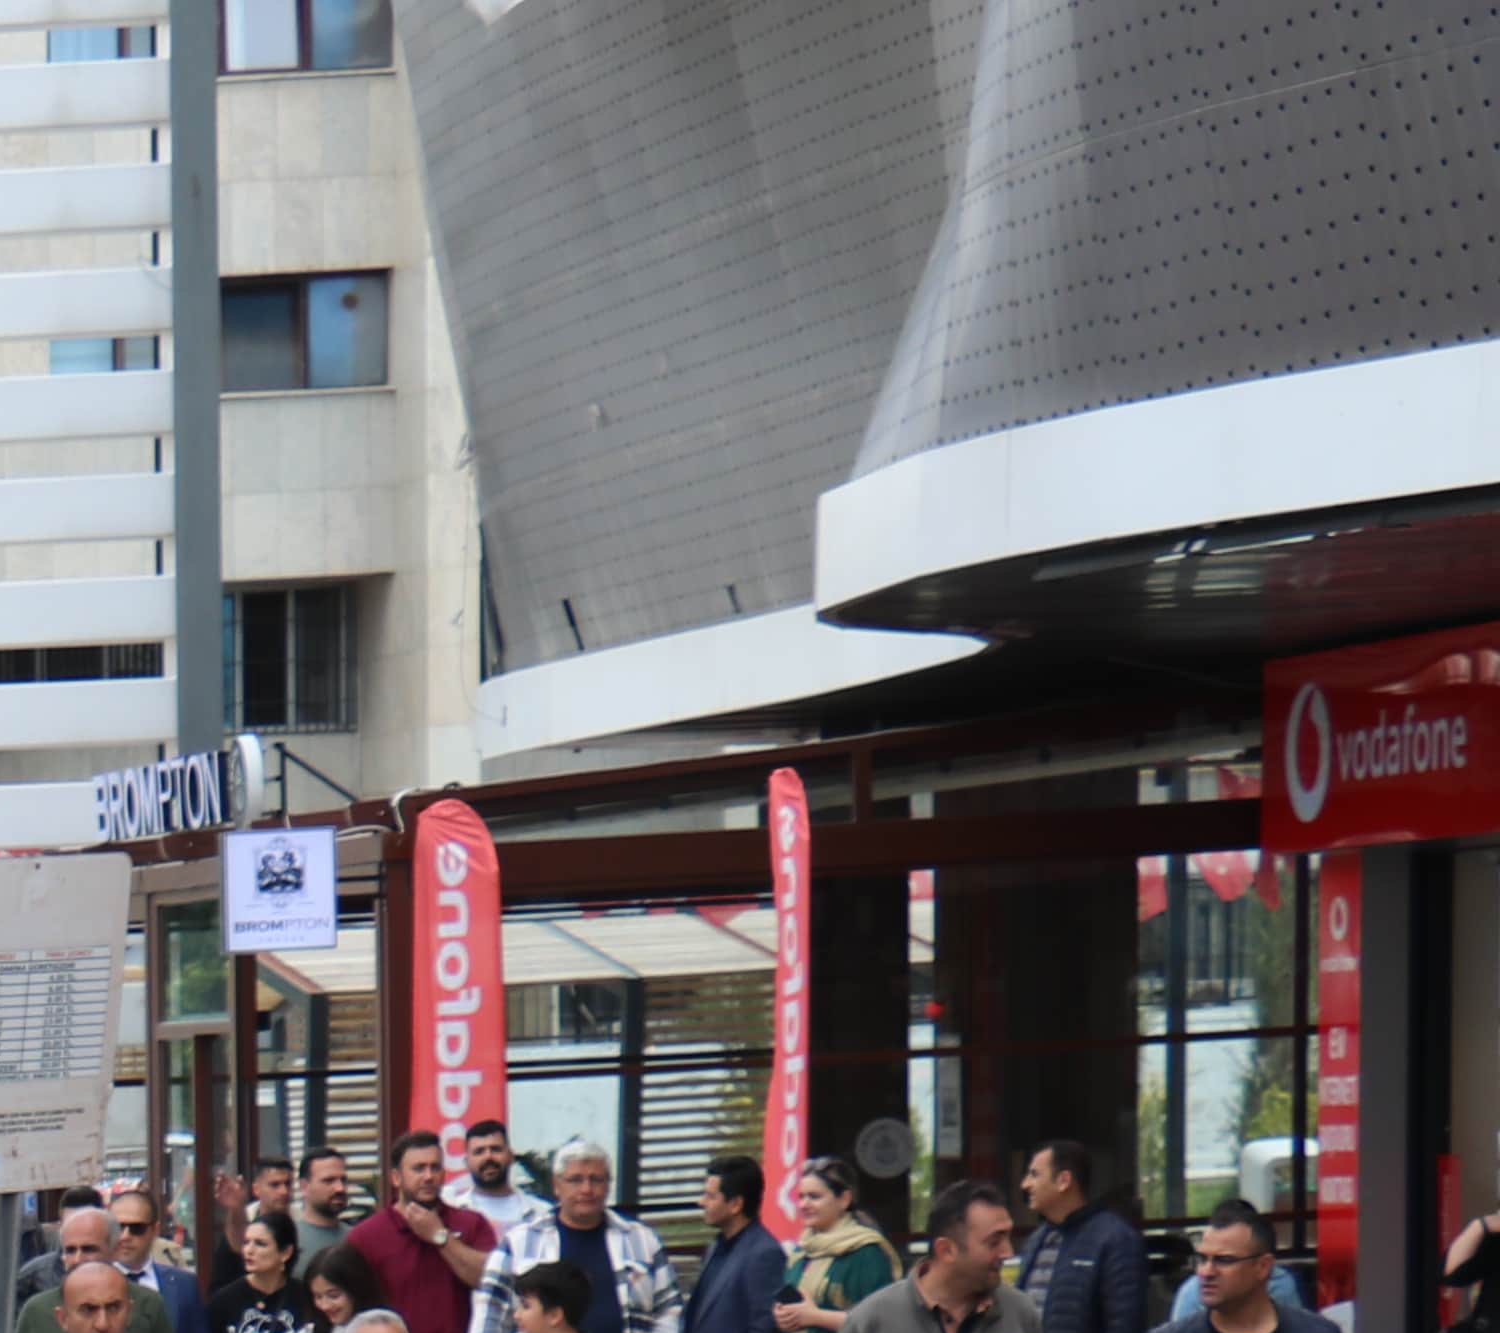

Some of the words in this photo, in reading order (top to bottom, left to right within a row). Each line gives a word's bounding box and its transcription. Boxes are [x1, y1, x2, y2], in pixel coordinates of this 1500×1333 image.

[1336, 703, 1468, 781] vodafone
[93, 751, 221, 842] BROMPTON
[233, 917, 330, 934] BROMPTON
